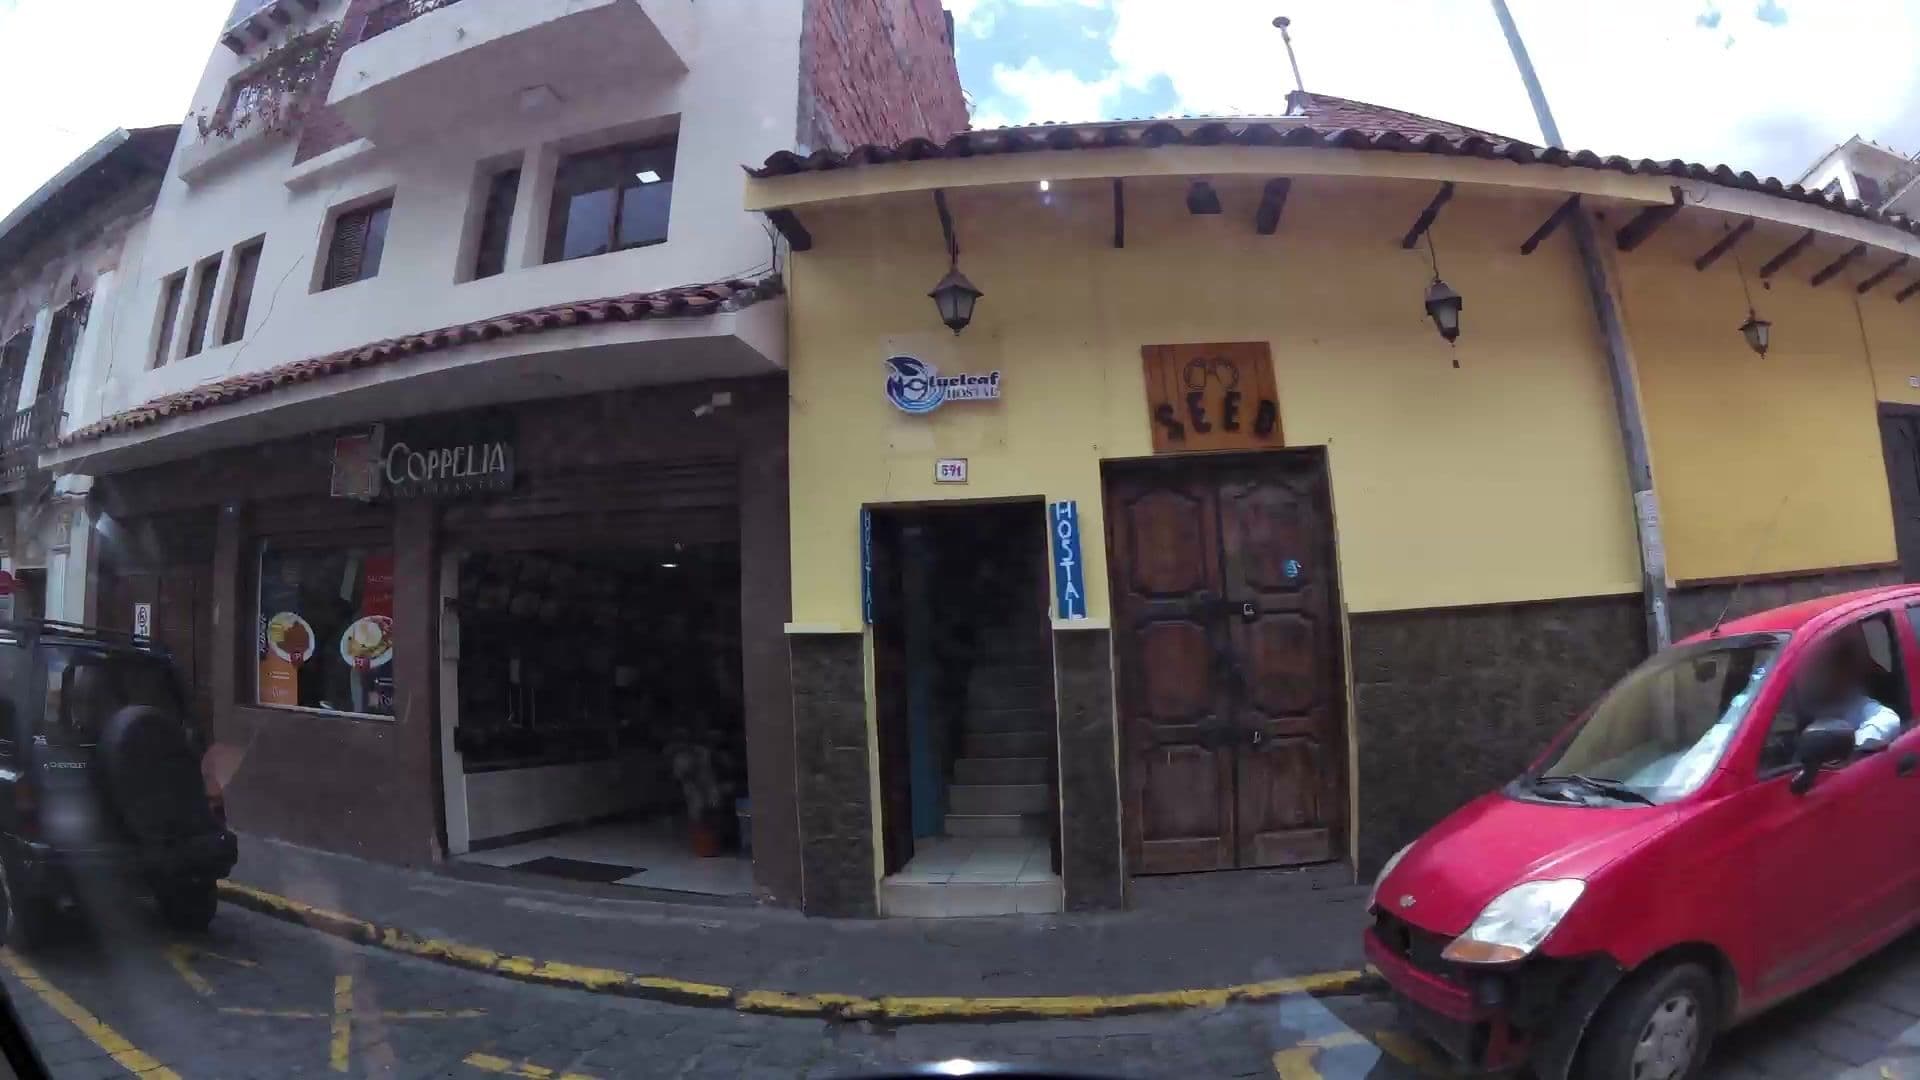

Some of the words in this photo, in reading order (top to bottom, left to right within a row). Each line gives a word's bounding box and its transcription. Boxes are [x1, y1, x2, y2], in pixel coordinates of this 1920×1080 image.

[1154, 391, 1278, 441] SEED
[386, 441, 506, 485] COPPELIA
[1055, 500, 1089, 621] HOSTAL
